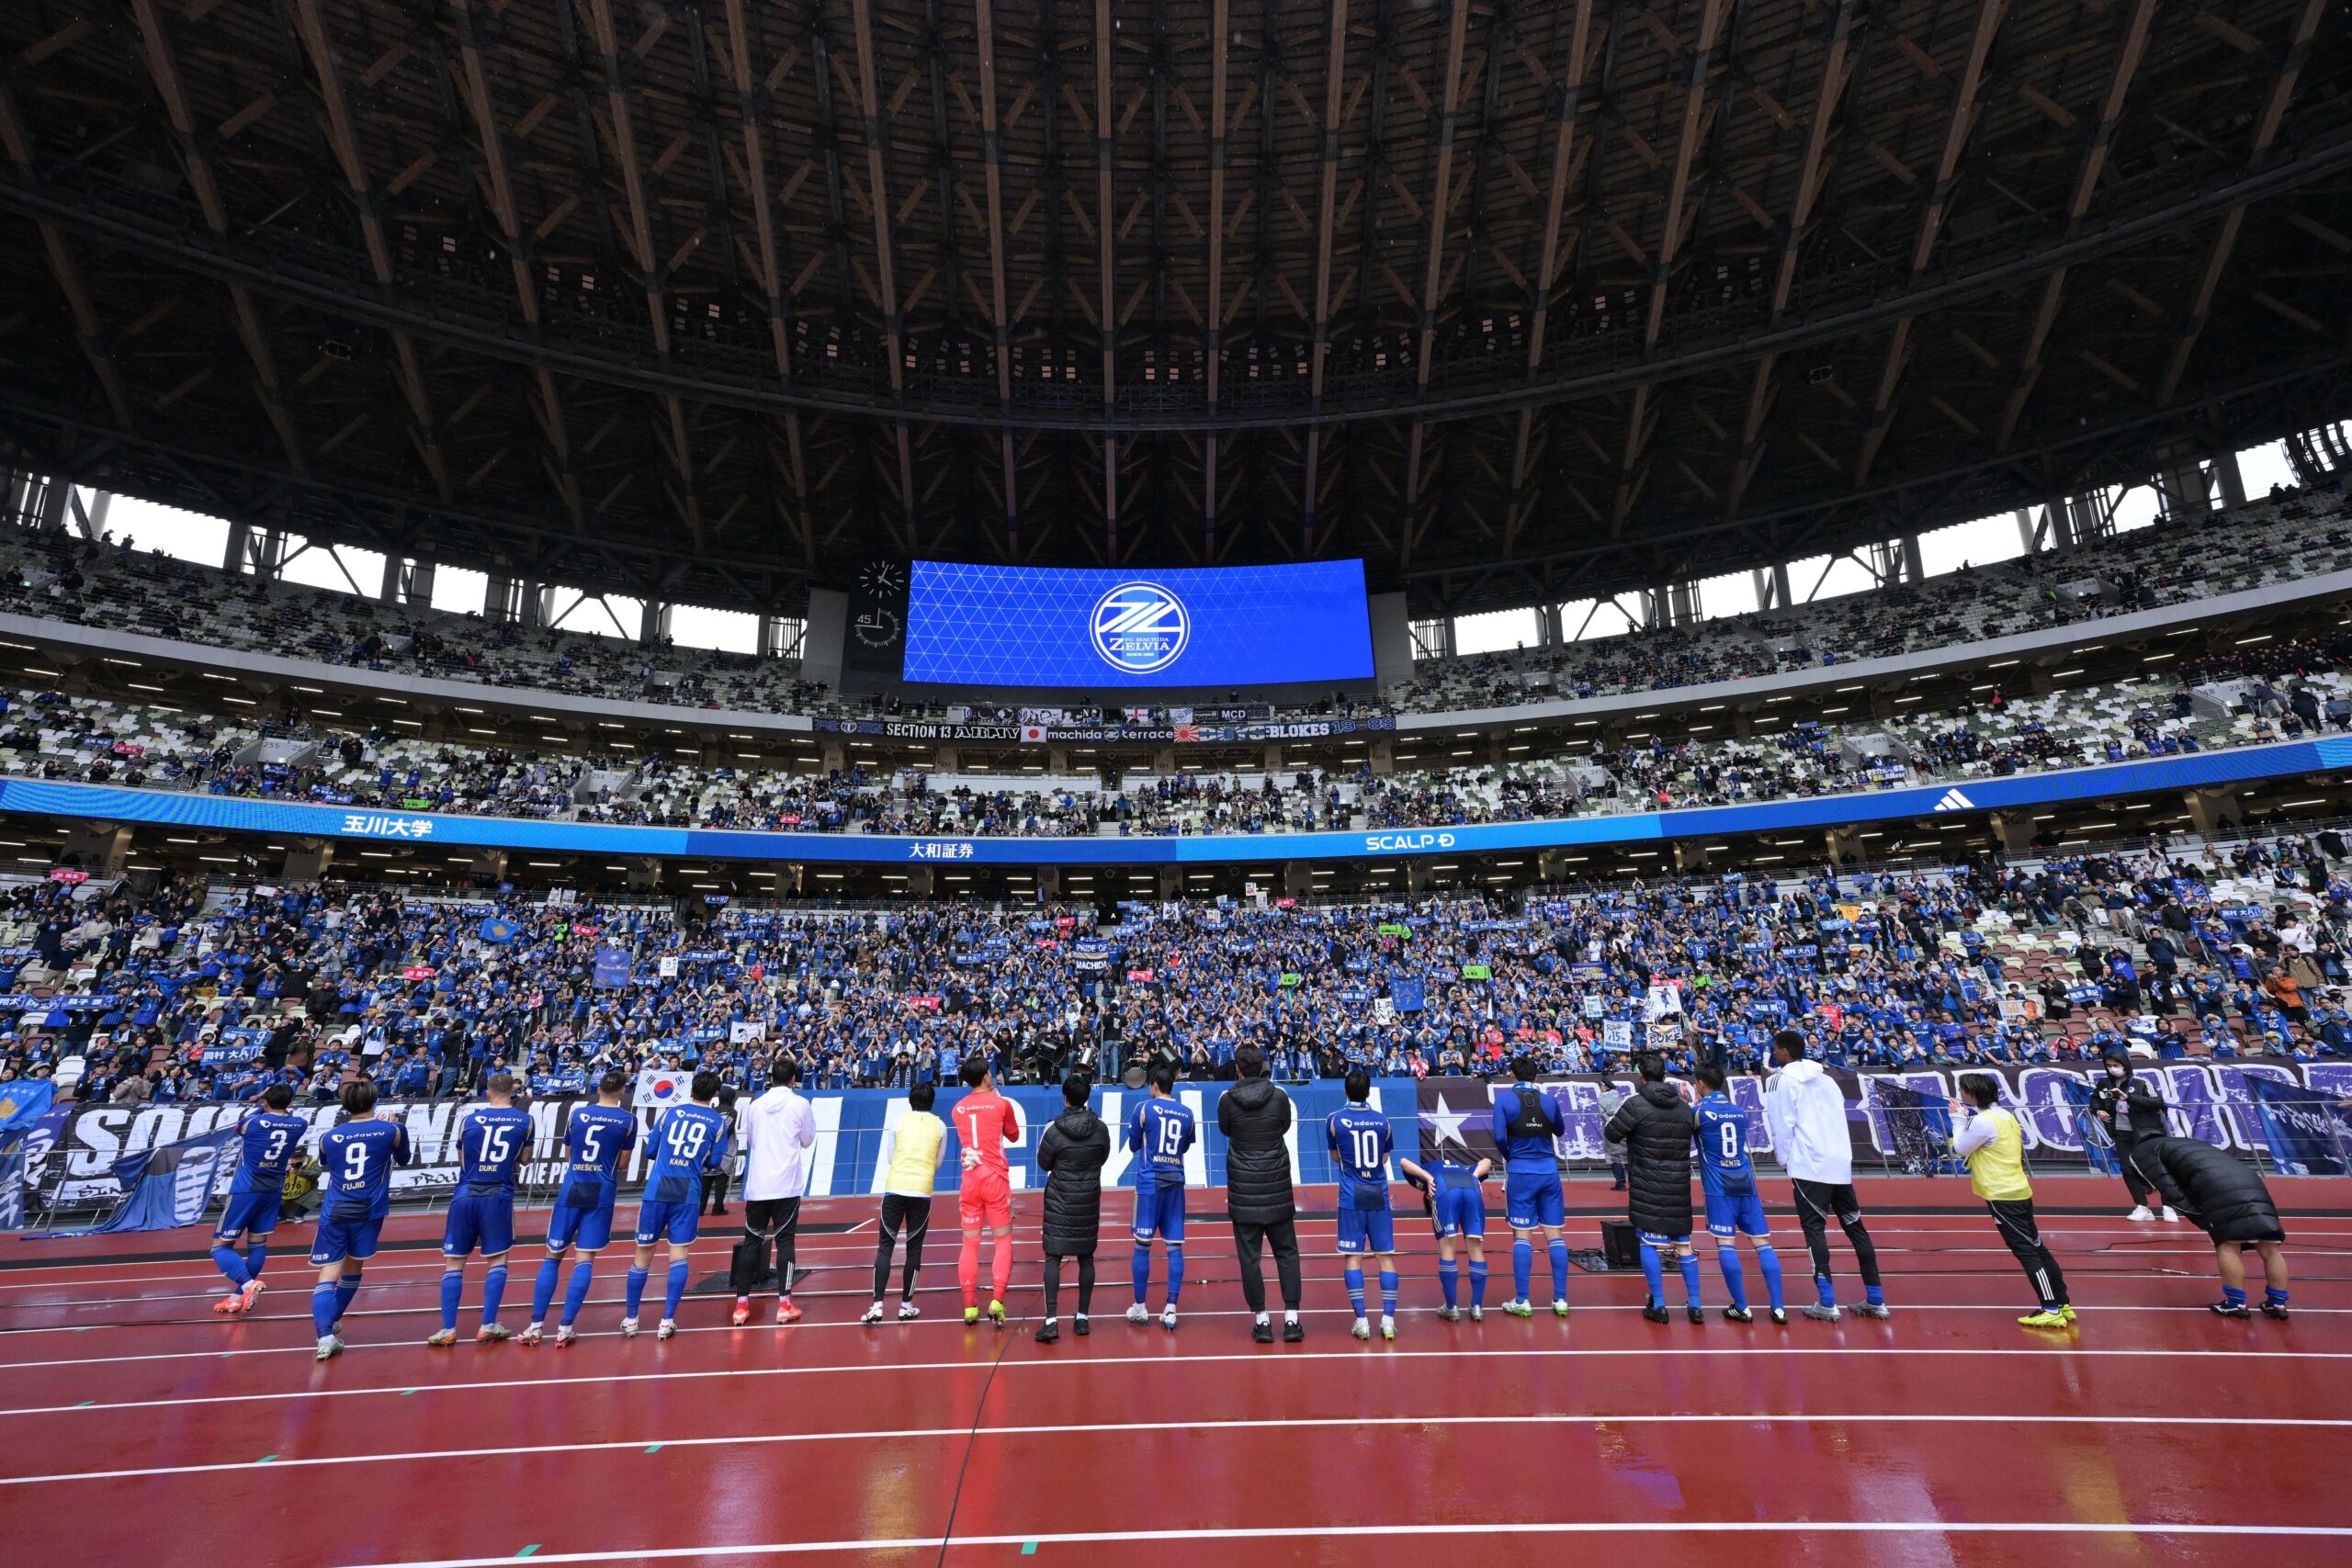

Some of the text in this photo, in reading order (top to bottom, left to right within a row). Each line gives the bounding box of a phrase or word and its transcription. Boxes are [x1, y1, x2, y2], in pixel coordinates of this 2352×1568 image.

[856, 615, 872, 625] 45
[1109, 637, 1170, 651] ZELVIA
[1221, 710, 1246, 718] MCD
[887, 723, 951, 739] SECTION 13
[955, 726, 1021, 739] ARMY
[1269, 723, 1329, 739] BLOKES
[1333, 717, 1396, 734] 19 89
[1047, 729, 1102, 740] machida
[1122, 729, 1174, 739] terrace
[263, 741, 280, 750] 255
[344, 815, 433, 838] 玉川大学
[908, 842, 974, 859] 大和証券
[1365, 834, 1435, 852] SCALP
[1076, 943, 1096, 953] PRIDE
[1076, 960, 1107, 971] MACHIDA
[967, 1113, 979, 1149] 1
[1158, 1116, 1183, 1156] 19
[264, 1130, 288, 1161] 3
[479, 1125, 515, 1163] 15
[581, 1125, 606, 1163] 5
[667, 1120, 707, 1159] 49
[1720, 1122, 1739, 1159] 8
[1349, 1130, 1379, 1169] 10
[344, 1142, 371, 1181] 9
[478, 1164, 498, 1173] DUKE
[669, 1157, 690, 1168] KANJI
[1152, 1156, 1182, 1167] NAKAYAMA
[518, 1162, 549, 1185] THE
[1361, 1171, 1372, 1179] NA
[341, 1180, 366, 1192] FUJIO
